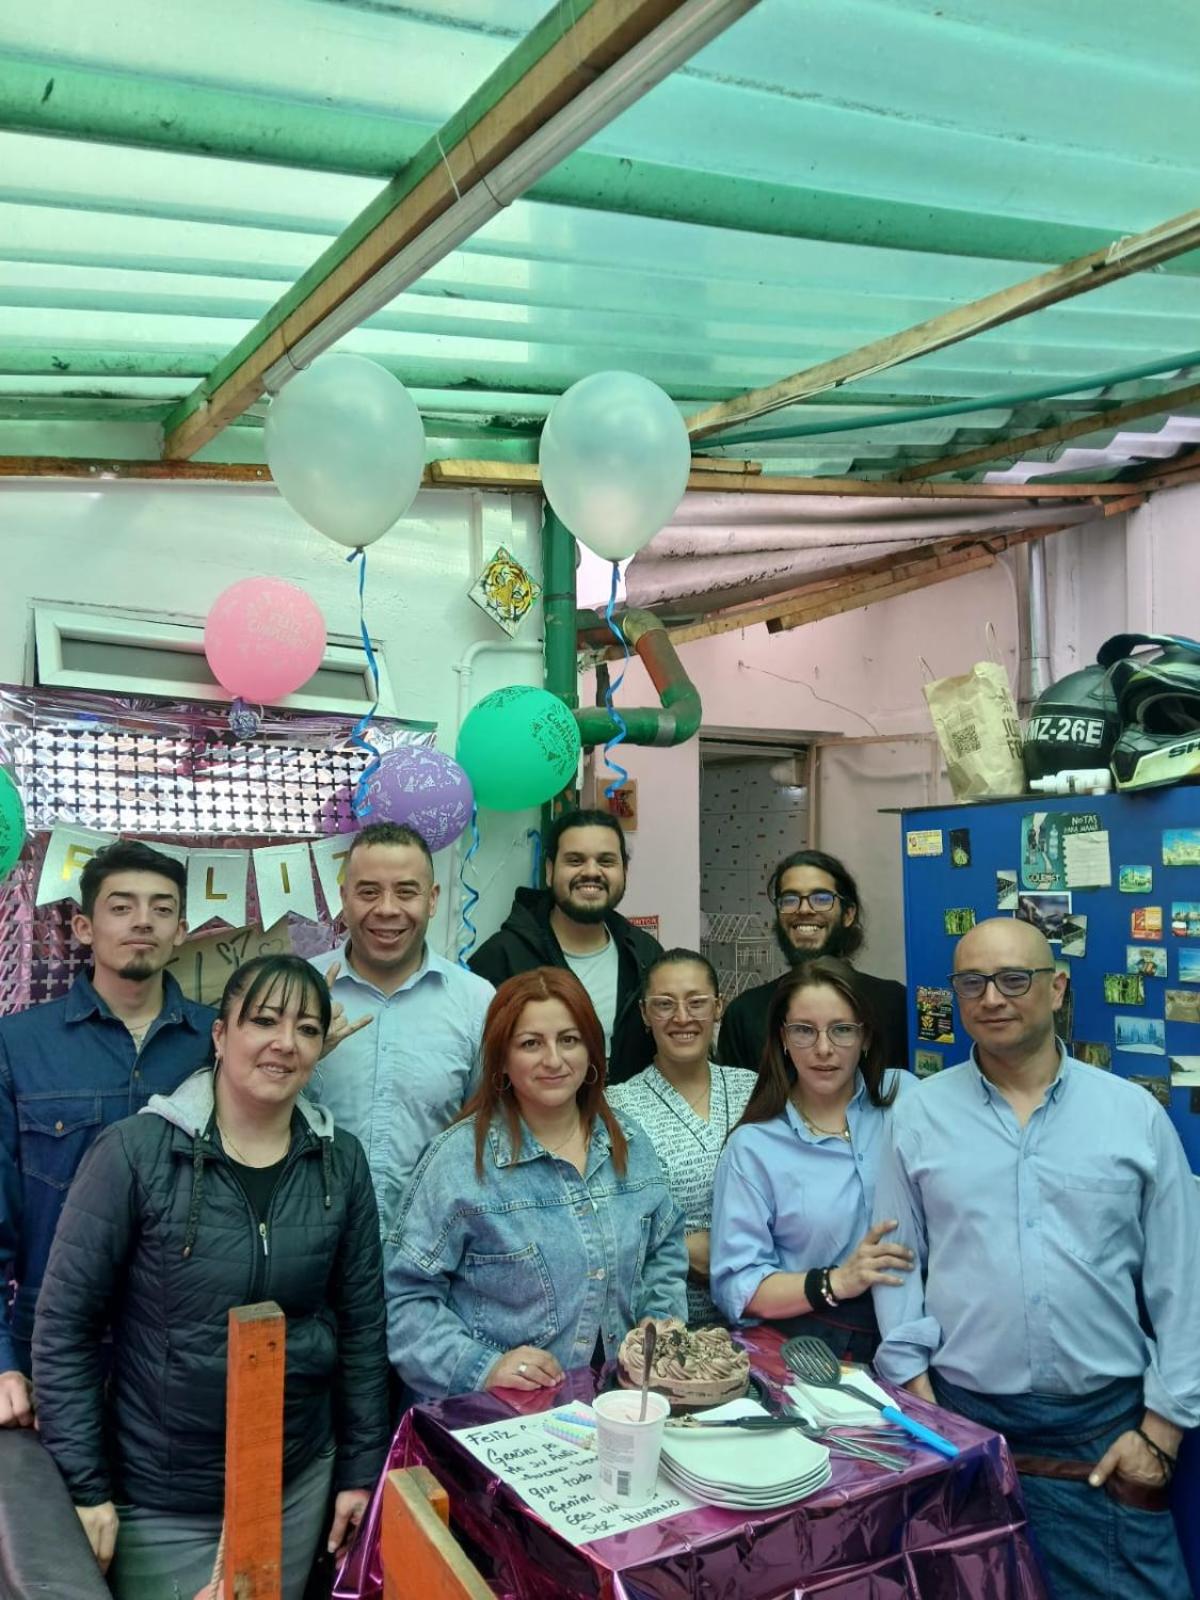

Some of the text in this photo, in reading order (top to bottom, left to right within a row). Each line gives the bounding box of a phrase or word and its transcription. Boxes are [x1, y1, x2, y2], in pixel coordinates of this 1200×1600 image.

[1071, 814, 1098, 826] NOTAS
[61, 843, 350, 899] FLI
[465, 1430, 518, 1446] Feliz
